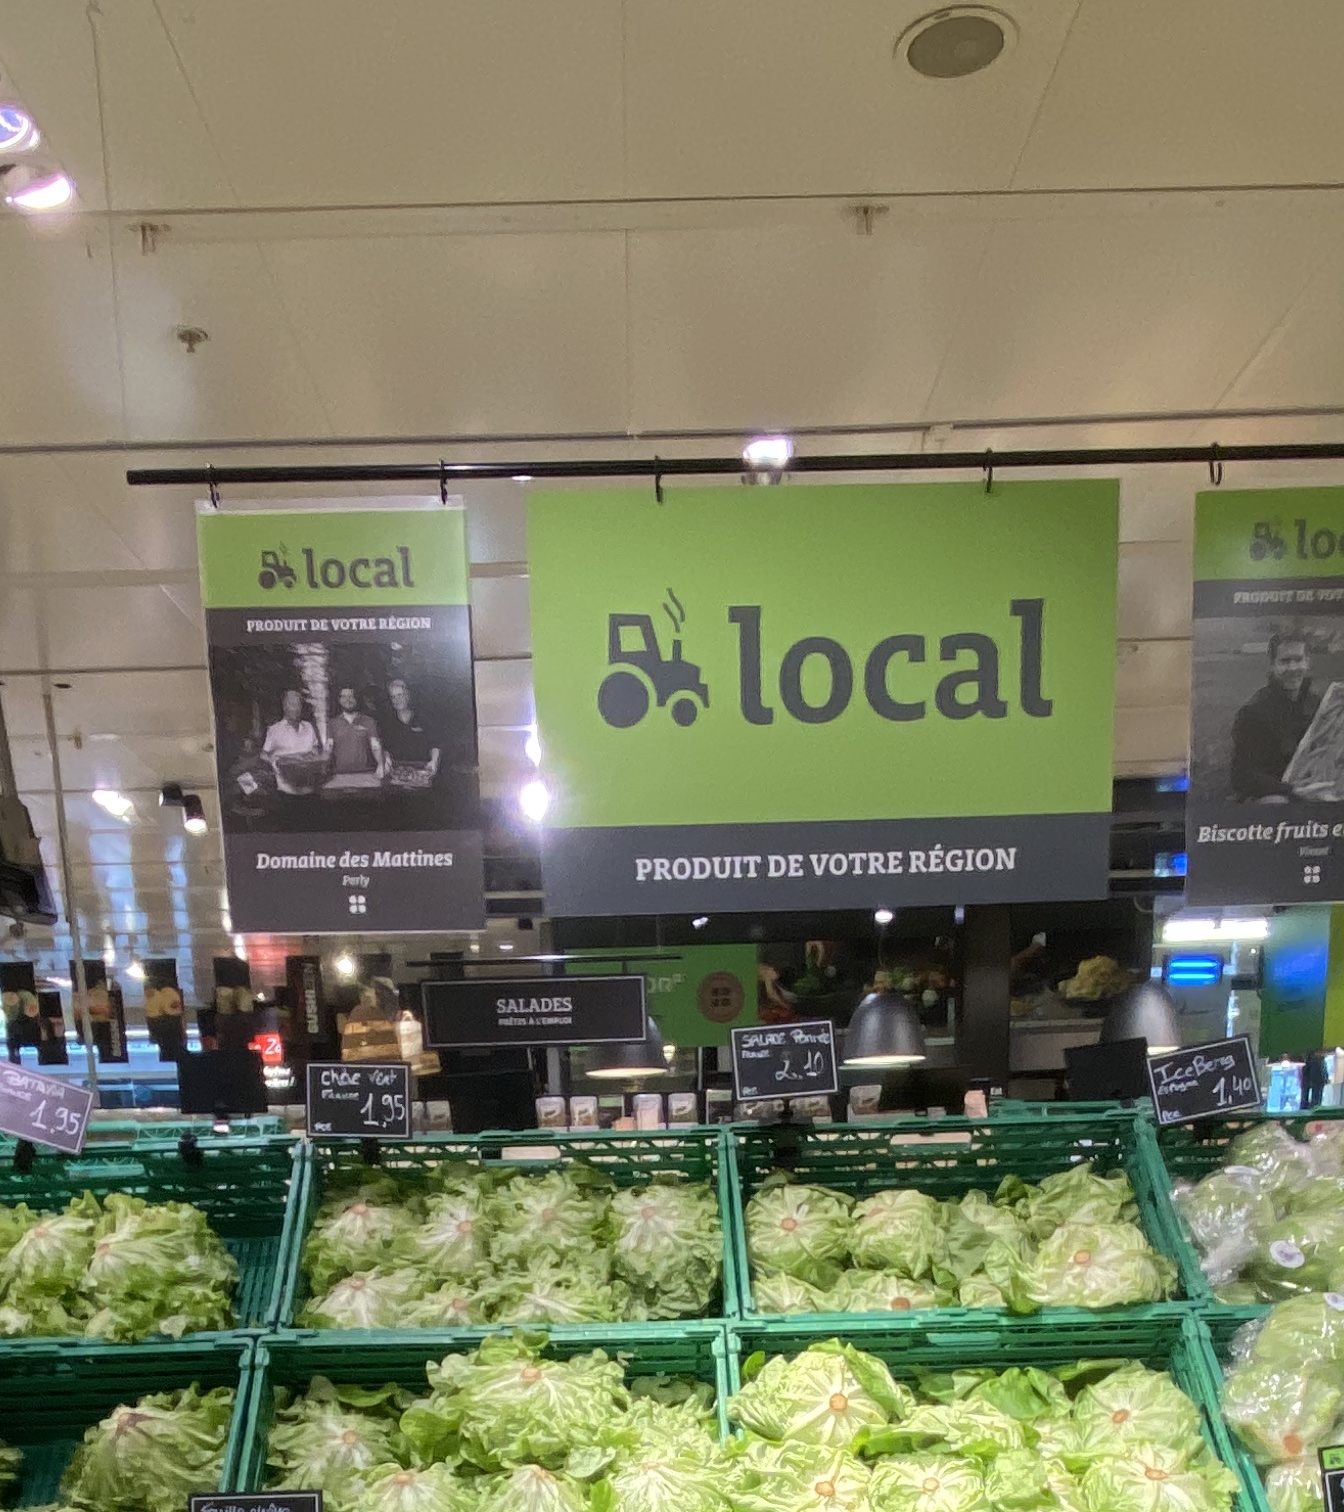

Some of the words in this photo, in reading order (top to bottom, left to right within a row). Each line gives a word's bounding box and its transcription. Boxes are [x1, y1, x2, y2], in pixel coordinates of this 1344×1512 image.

[301, 545, 415, 588] local
[246, 619, 307, 633] PRODUIT
[310, 619, 328, 631] DE
[330, 617, 376, 631] VOTRE
[379, 614, 432, 630] RÉGION
[728, 598, 1053, 725] local
[1197, 823, 1273, 843] Biscotte
[1273, 819, 1329, 844] fruits
[256, 850, 336, 869] Domaine
[339, 850, 369, 868] des
[372, 849, 453, 868] Mattines
[635, 852, 761, 881] PRODUIT
[768, 853, 804, 878] DE
[810, 849, 903, 877] VOTRE
[908, 843, 1017, 874] RÉGION
[497, 997, 573, 1014] SALADES
